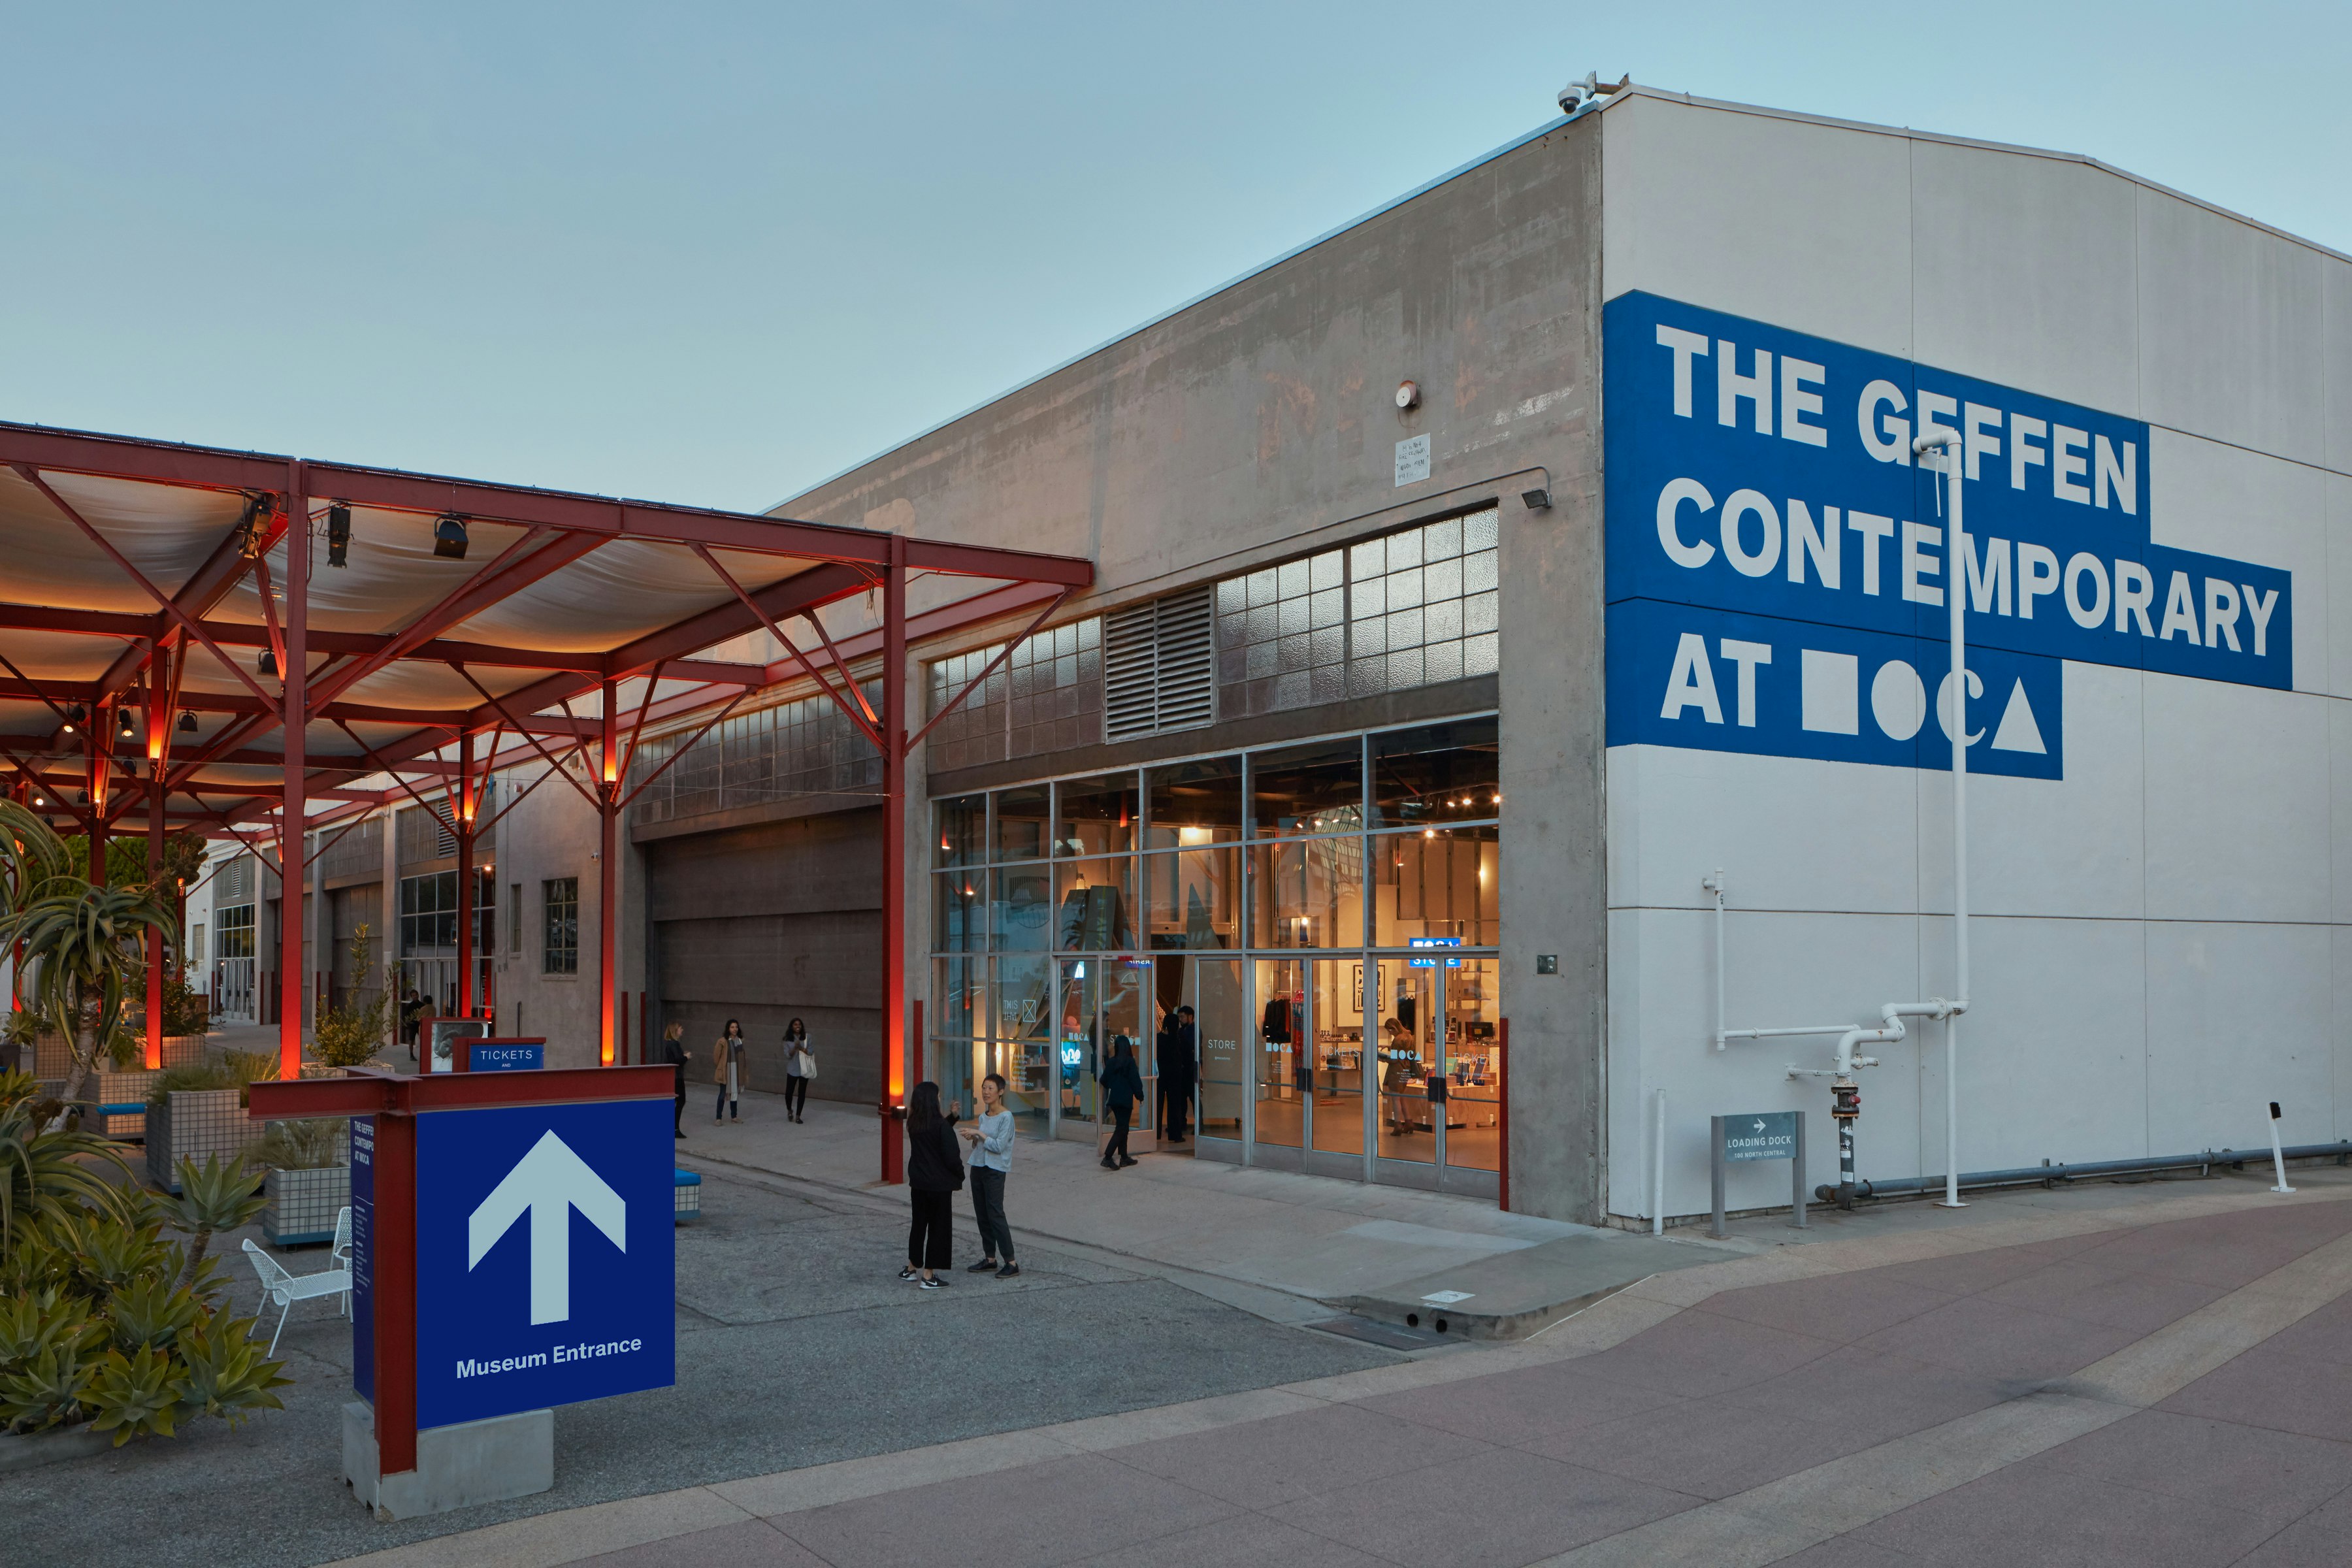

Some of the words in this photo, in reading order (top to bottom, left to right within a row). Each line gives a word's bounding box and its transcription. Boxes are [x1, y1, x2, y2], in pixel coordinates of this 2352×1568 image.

[1656, 323, 1827, 448] THE
[1857, 379, 2136, 516] GEFFEN
[1656, 477, 2279, 657] CONTEMPORARY
[1660, 632, 1772, 728] AT
[1208, 1039, 1236, 1050] STORE
[1318, 1045, 1360, 1057] TICKETS
[480, 1050, 532, 1060] TICKETS
[1452, 1053, 1500, 1064] TICKETS
[1727, 1137, 1766, 1148] LOADING
[1769, 1135, 1791, 1145] DOCK
[457, 1352, 547, 1379] Museum
[553, 1338, 642, 1364] Entrance
